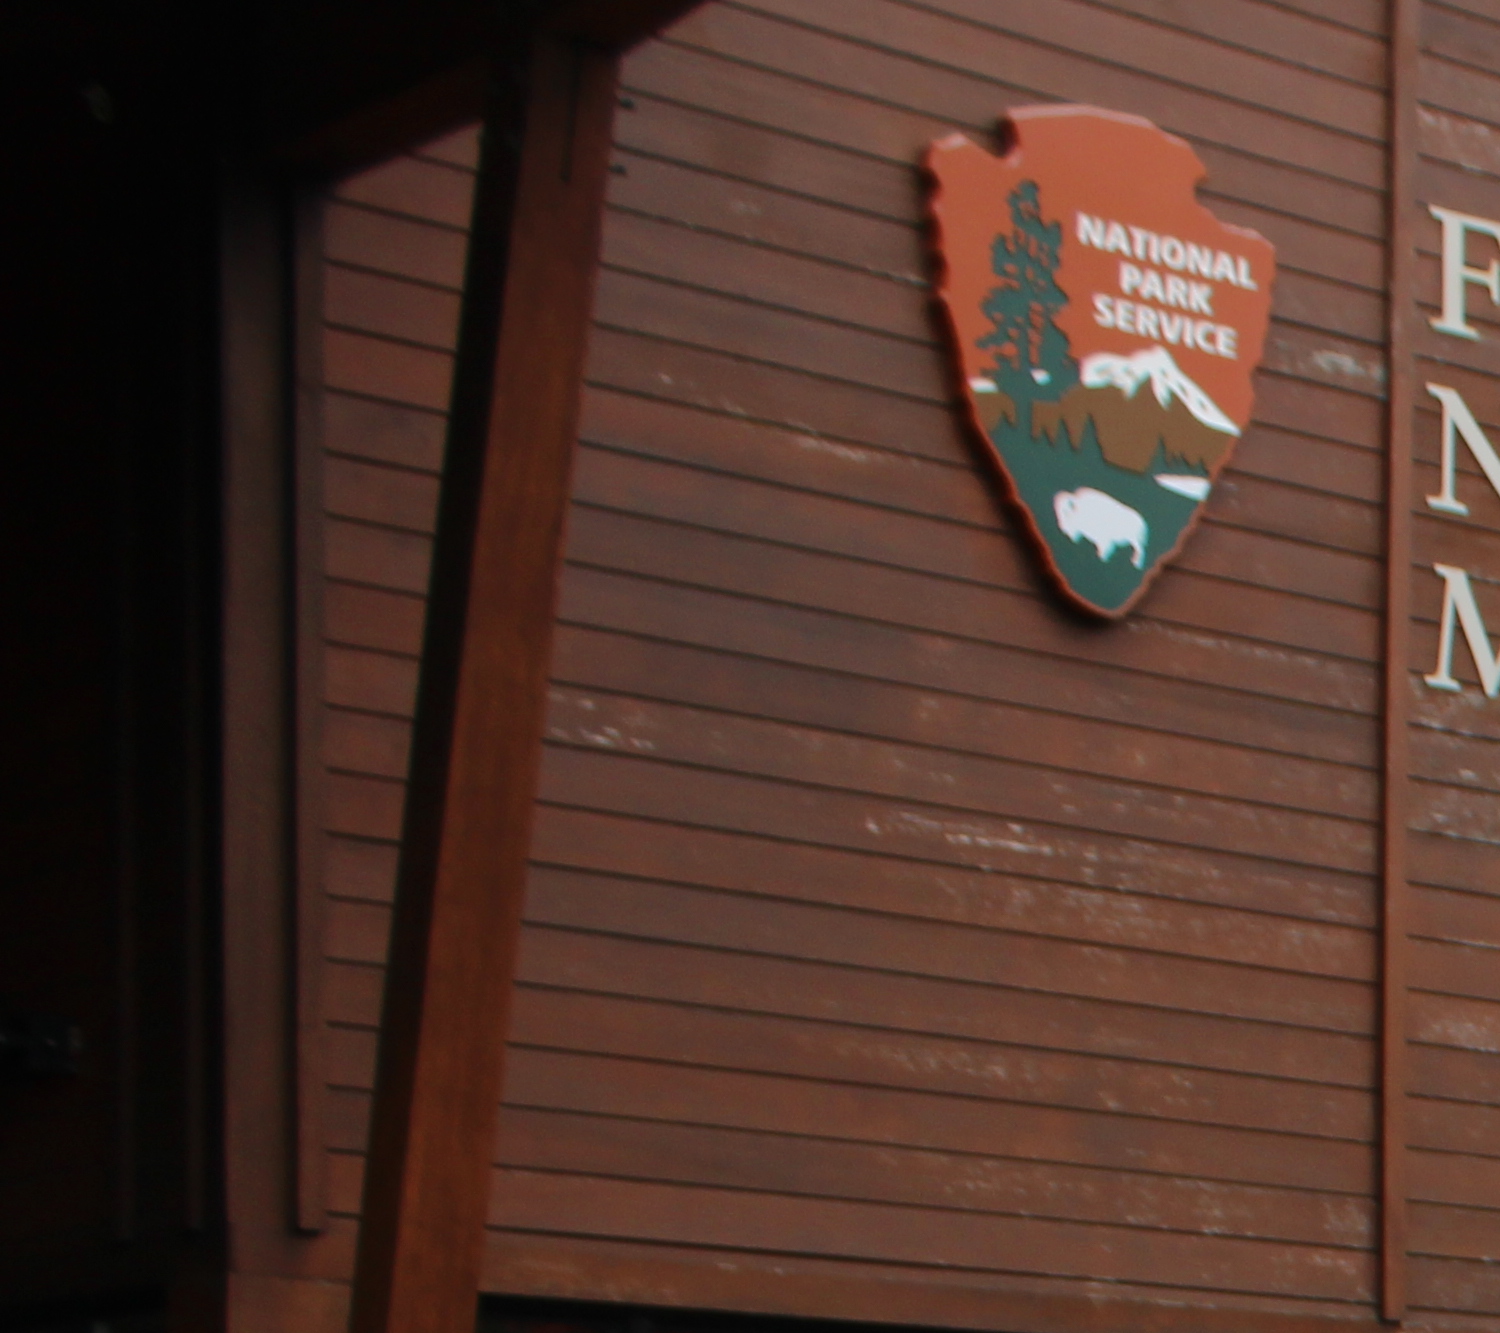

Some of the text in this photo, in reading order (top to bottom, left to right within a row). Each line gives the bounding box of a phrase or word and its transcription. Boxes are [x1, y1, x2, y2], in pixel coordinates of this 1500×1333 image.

[1076, 211, 1258, 291] NATIONAL
[1119, 260, 1214, 316] PARK
[1092, 293, 1238, 360] SERVICE
